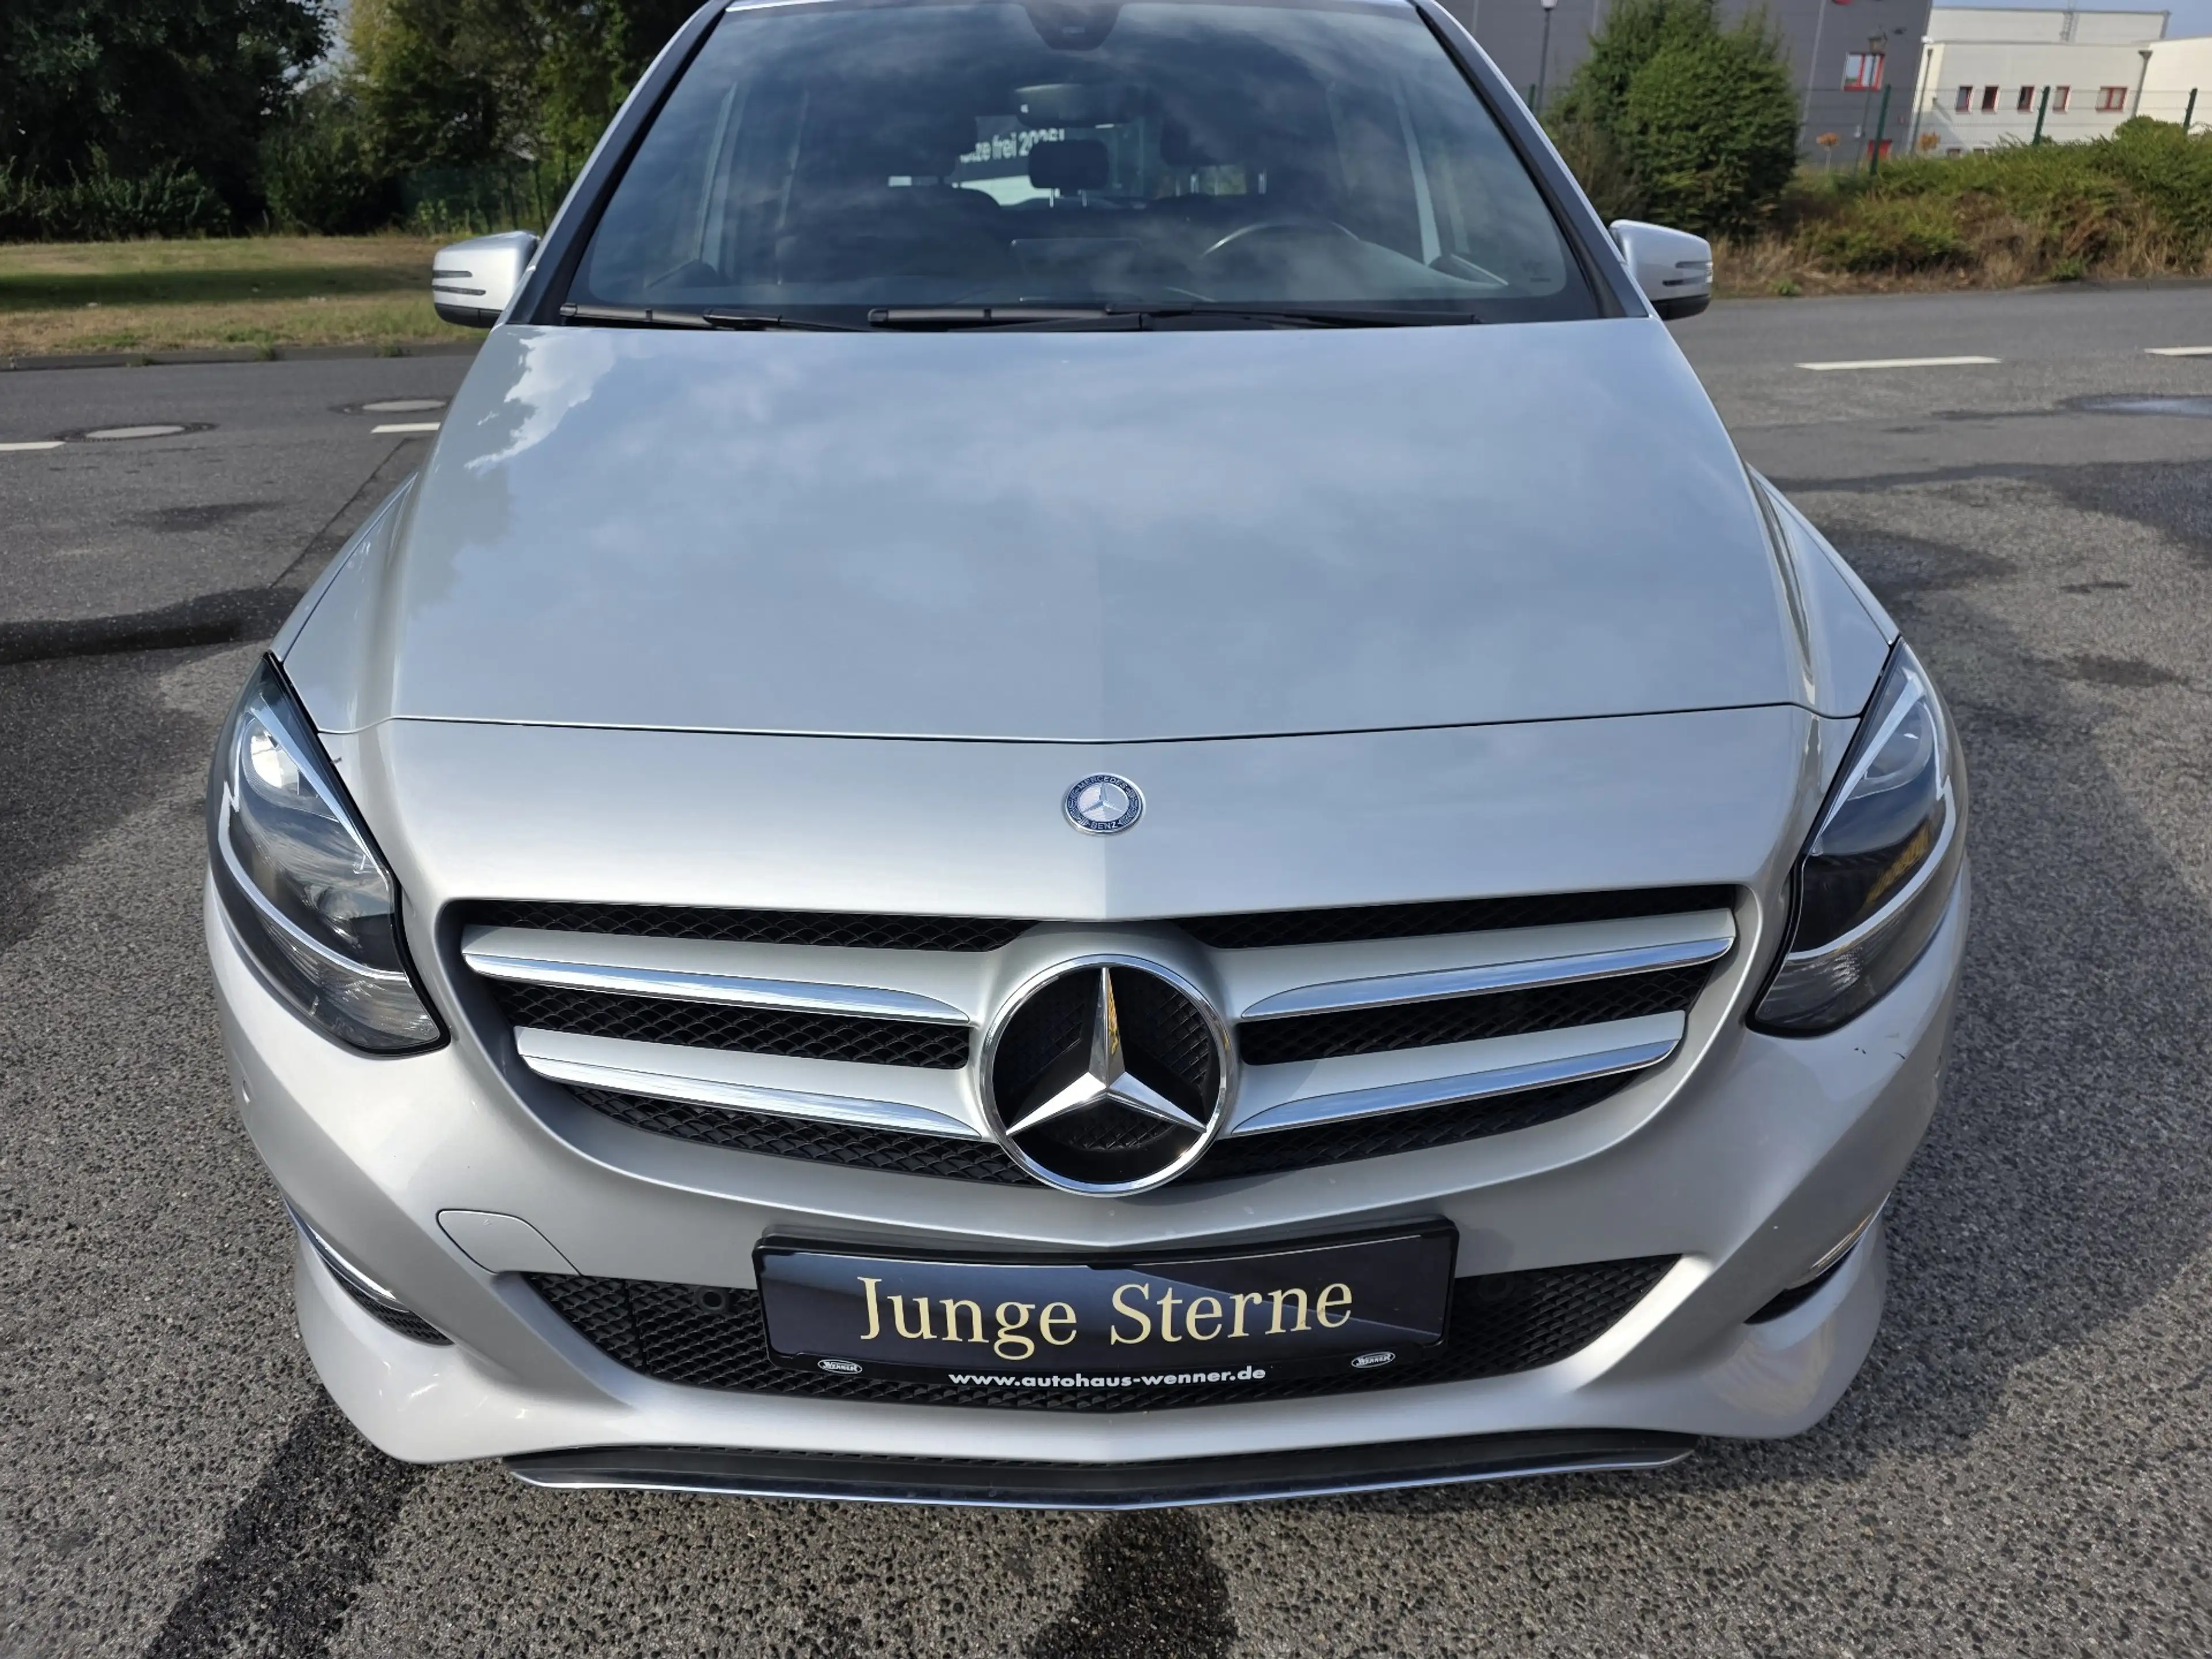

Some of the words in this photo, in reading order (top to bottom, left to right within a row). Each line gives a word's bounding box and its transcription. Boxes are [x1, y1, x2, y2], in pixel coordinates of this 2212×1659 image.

[1090, 821, 1118, 830] BENZ
[858, 1275, 1077, 1359] Junge
[1109, 1282, 1353, 1345] Sterne
[948, 1365, 1266, 1388] www.autohaus-wenner.de
